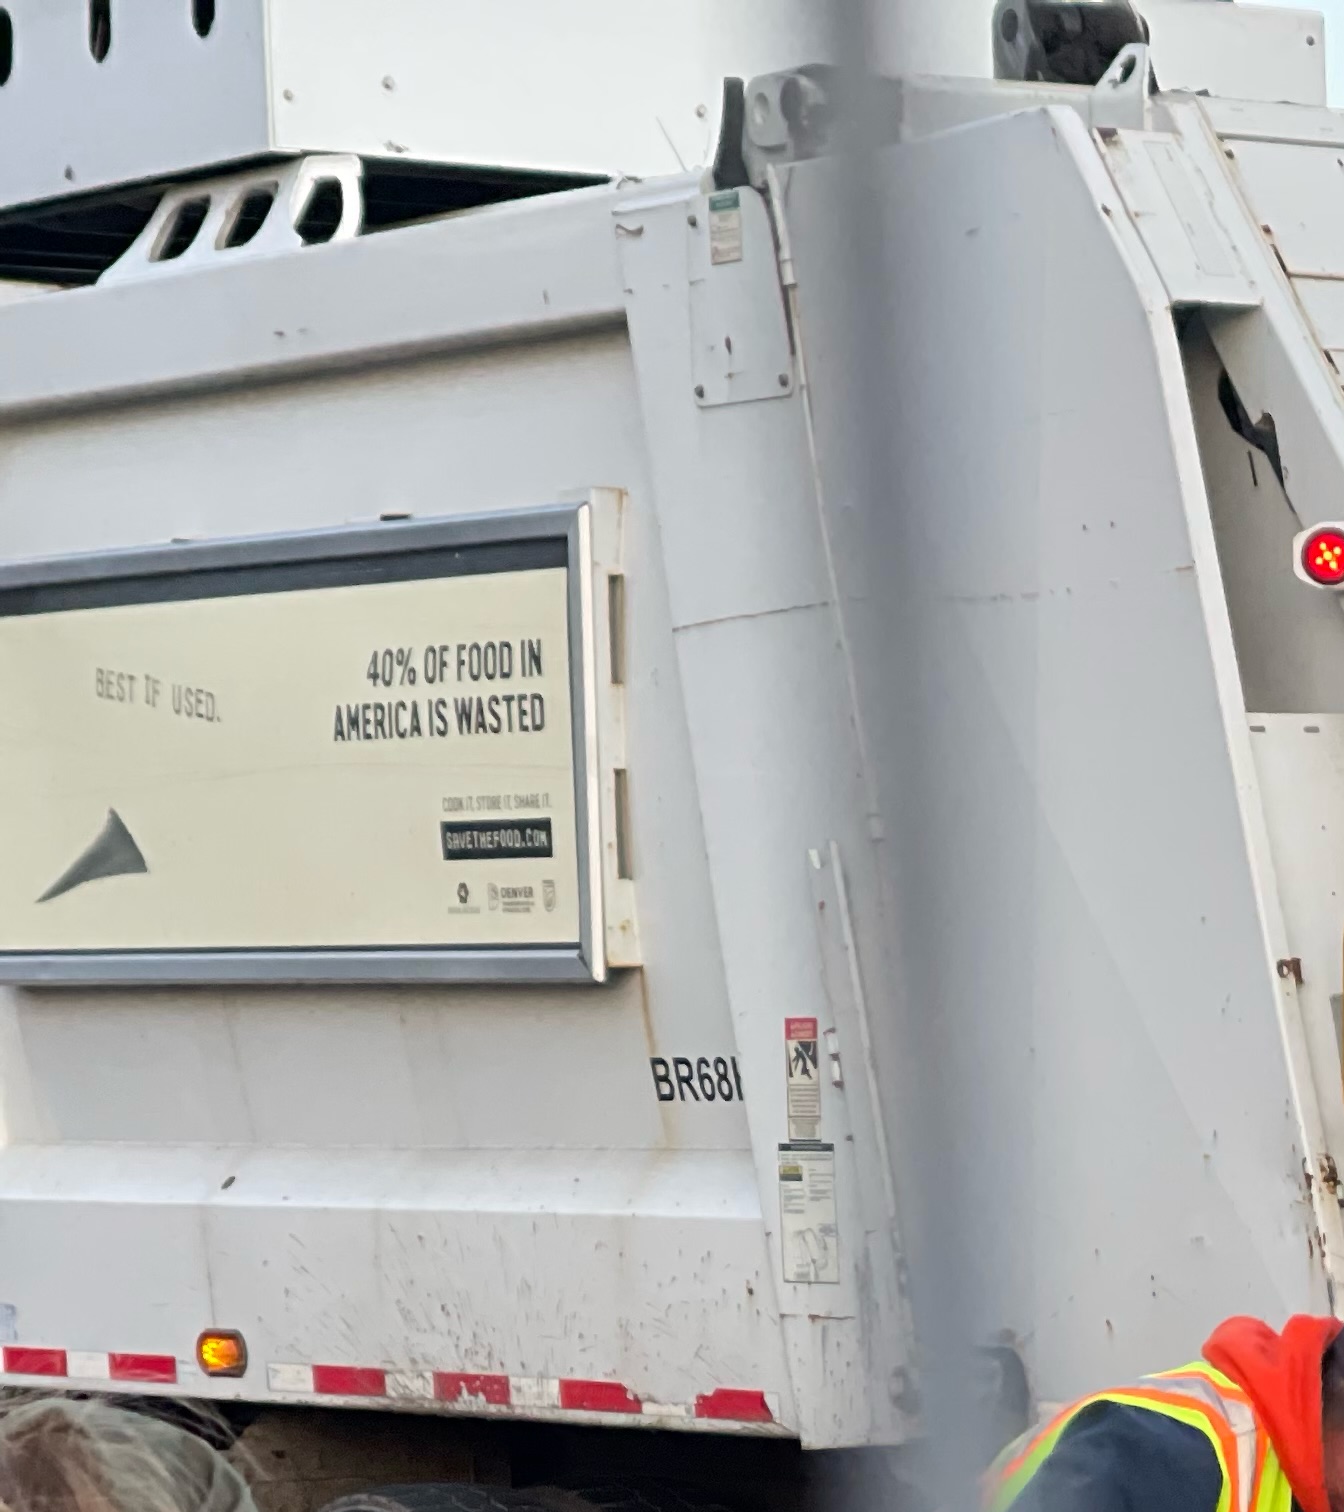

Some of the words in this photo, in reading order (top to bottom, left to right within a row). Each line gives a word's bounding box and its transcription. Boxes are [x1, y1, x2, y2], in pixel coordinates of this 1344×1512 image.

[366, 646, 416, 687] 40%
[424, 644, 449, 684] OF
[456, 641, 513, 682] FOOD
[520, 638, 543, 677] IN
[96, 666, 137, 704] BEST
[144, 673, 161, 708] IF
[171, 684, 222, 723] USED.
[333, 700, 422, 742] AMERICA
[428, 697, 449, 738] IS
[453, 692, 545, 735] WASTED
[445, 827, 549, 850] SAVETHEFOOD.COM
